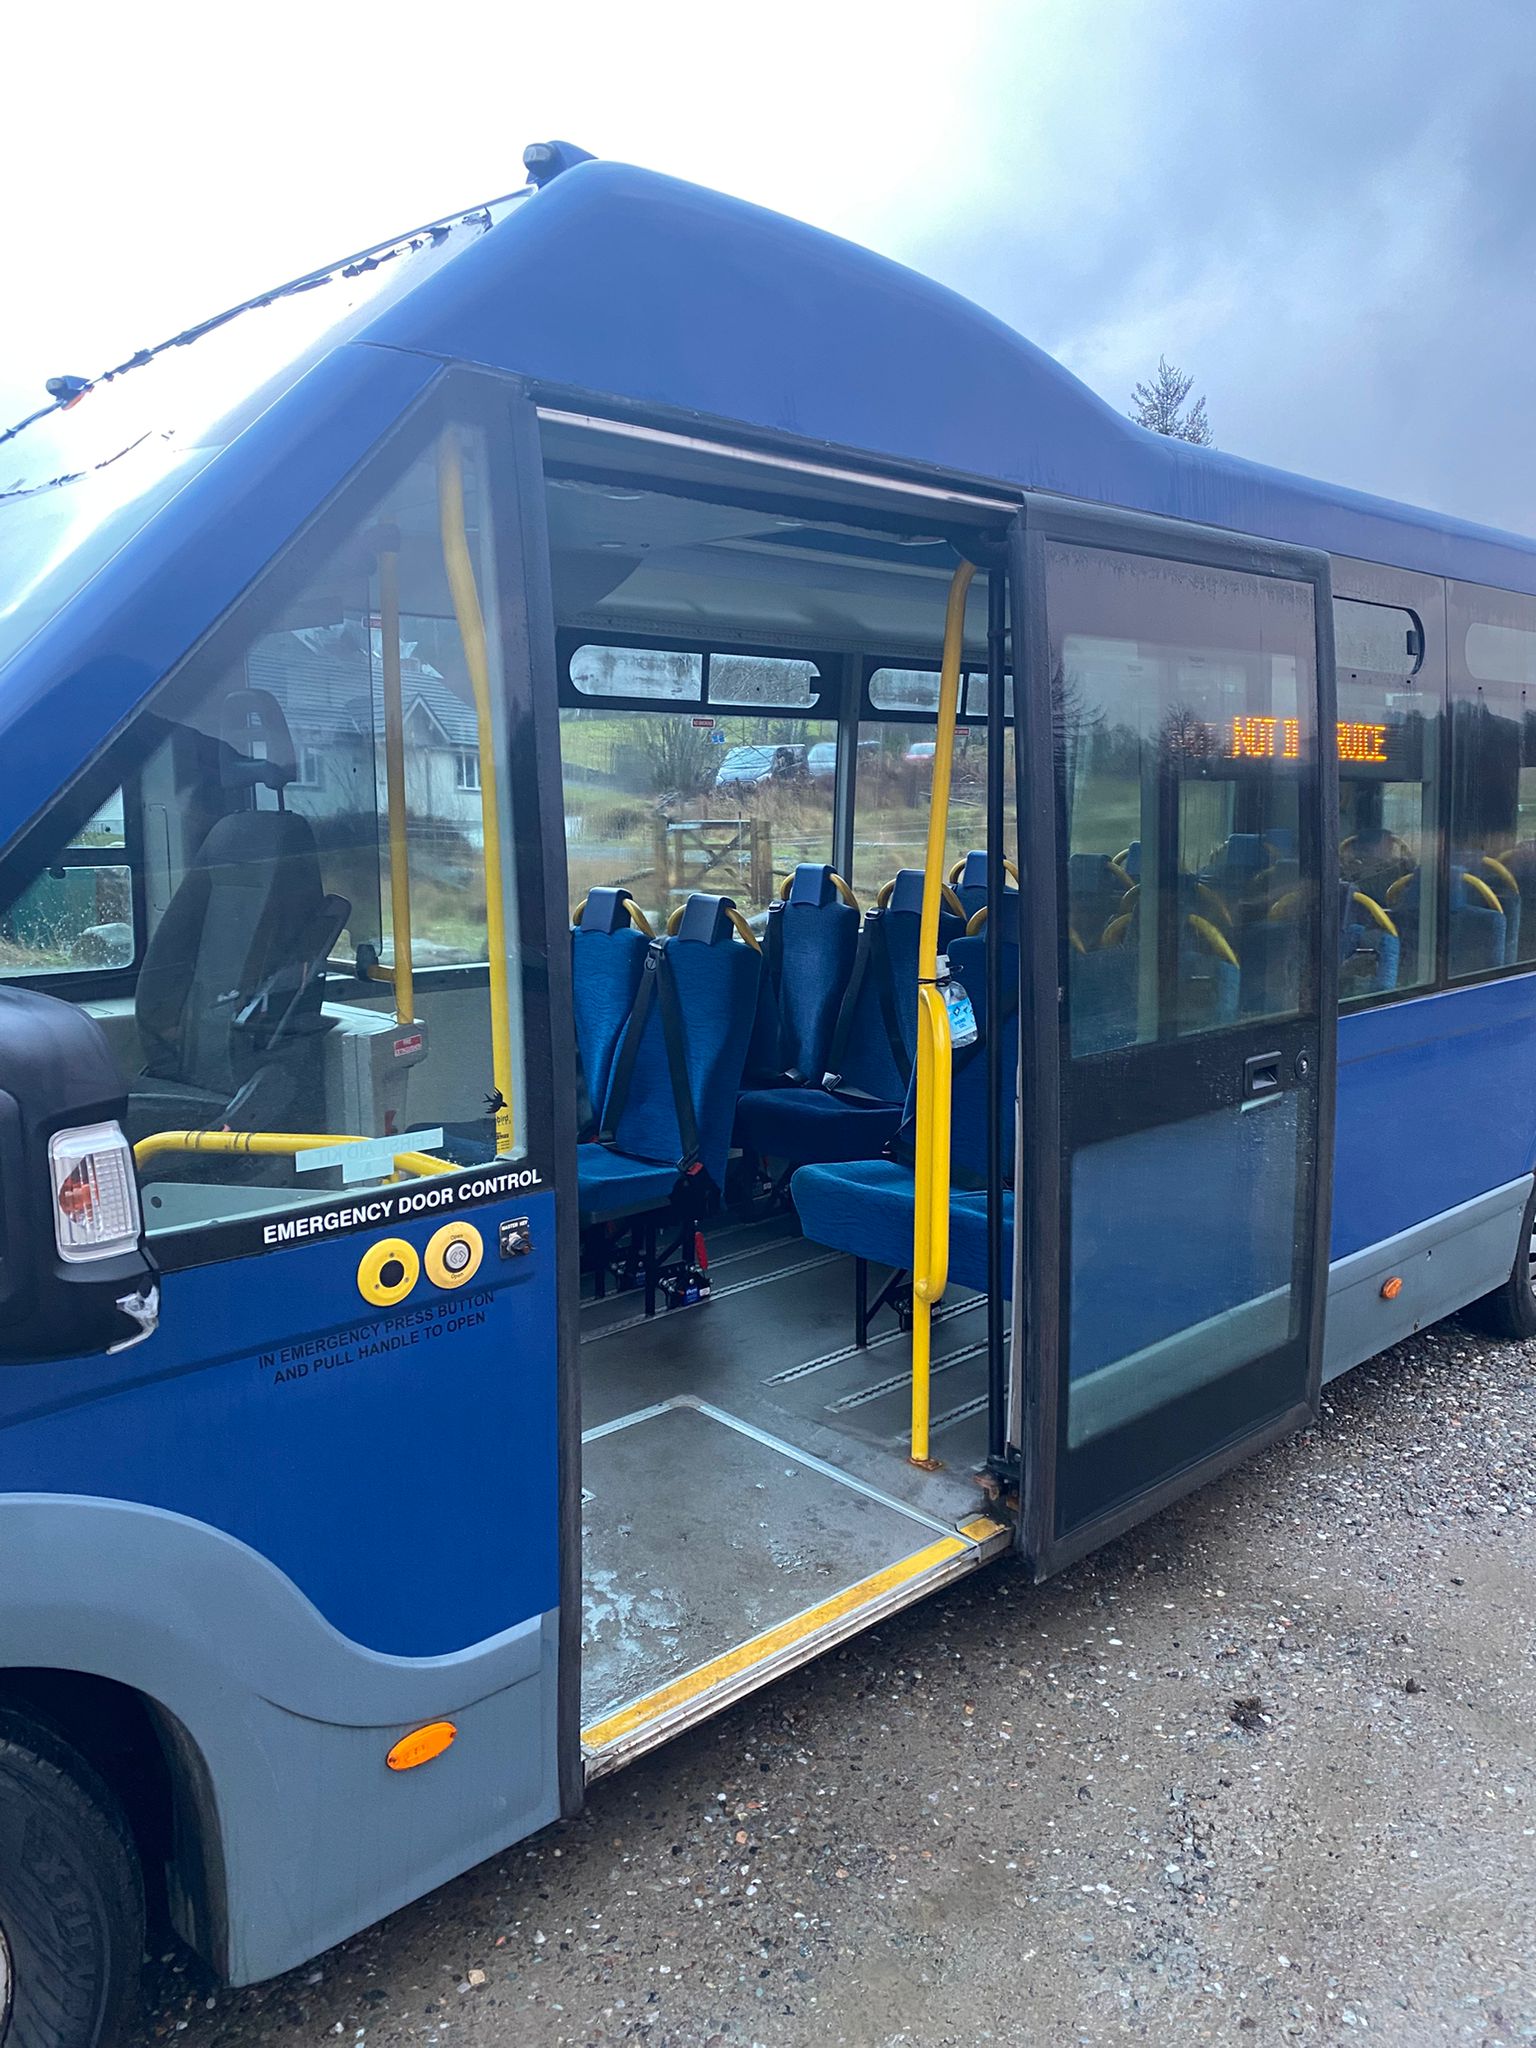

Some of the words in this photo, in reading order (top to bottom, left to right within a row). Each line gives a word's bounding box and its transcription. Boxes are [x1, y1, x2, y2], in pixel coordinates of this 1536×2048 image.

[1233, 716, 1276, 757] NOT
[1337, 722, 1387, 762] RVICE
[263, 1200, 394, 1244] EMERGENCY
[398, 1187, 453, 1214] DOOR
[458, 1169, 542, 1200] CONTROL
[450, 1233, 463, 1241] Open
[451, 1272, 464, 1280] Open
[258, 1353, 275, 1369] IN
[280, 1324, 380, 1363] EMERGENCY
[385, 1309, 433, 1333] PRESS
[438, 1291, 494, 1317] BUTTON
[274, 1364, 309, 1384] AND
[313, 1351, 354, 1373] PULL
[359, 1331, 419, 1359] HANDLE
[424, 1325, 443, 1339] TO
[447, 1312, 486, 1333] OPEN
